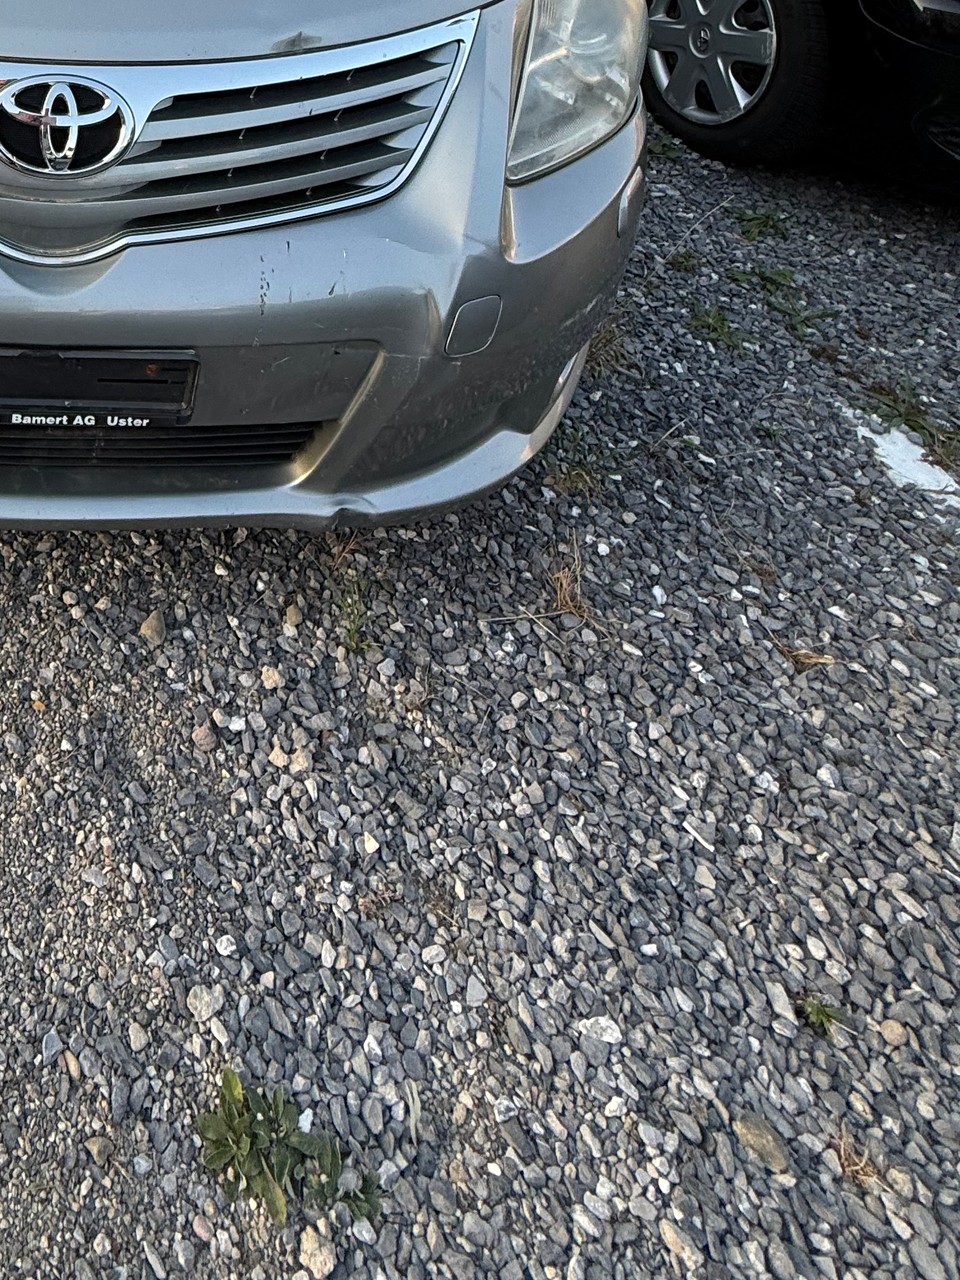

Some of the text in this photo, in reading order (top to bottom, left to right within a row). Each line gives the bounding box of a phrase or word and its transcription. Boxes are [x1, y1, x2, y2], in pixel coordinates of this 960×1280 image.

[11, 413, 68, 425] Bamert
[72, 415, 95, 426] AG
[106, 416, 149, 427] Uster
